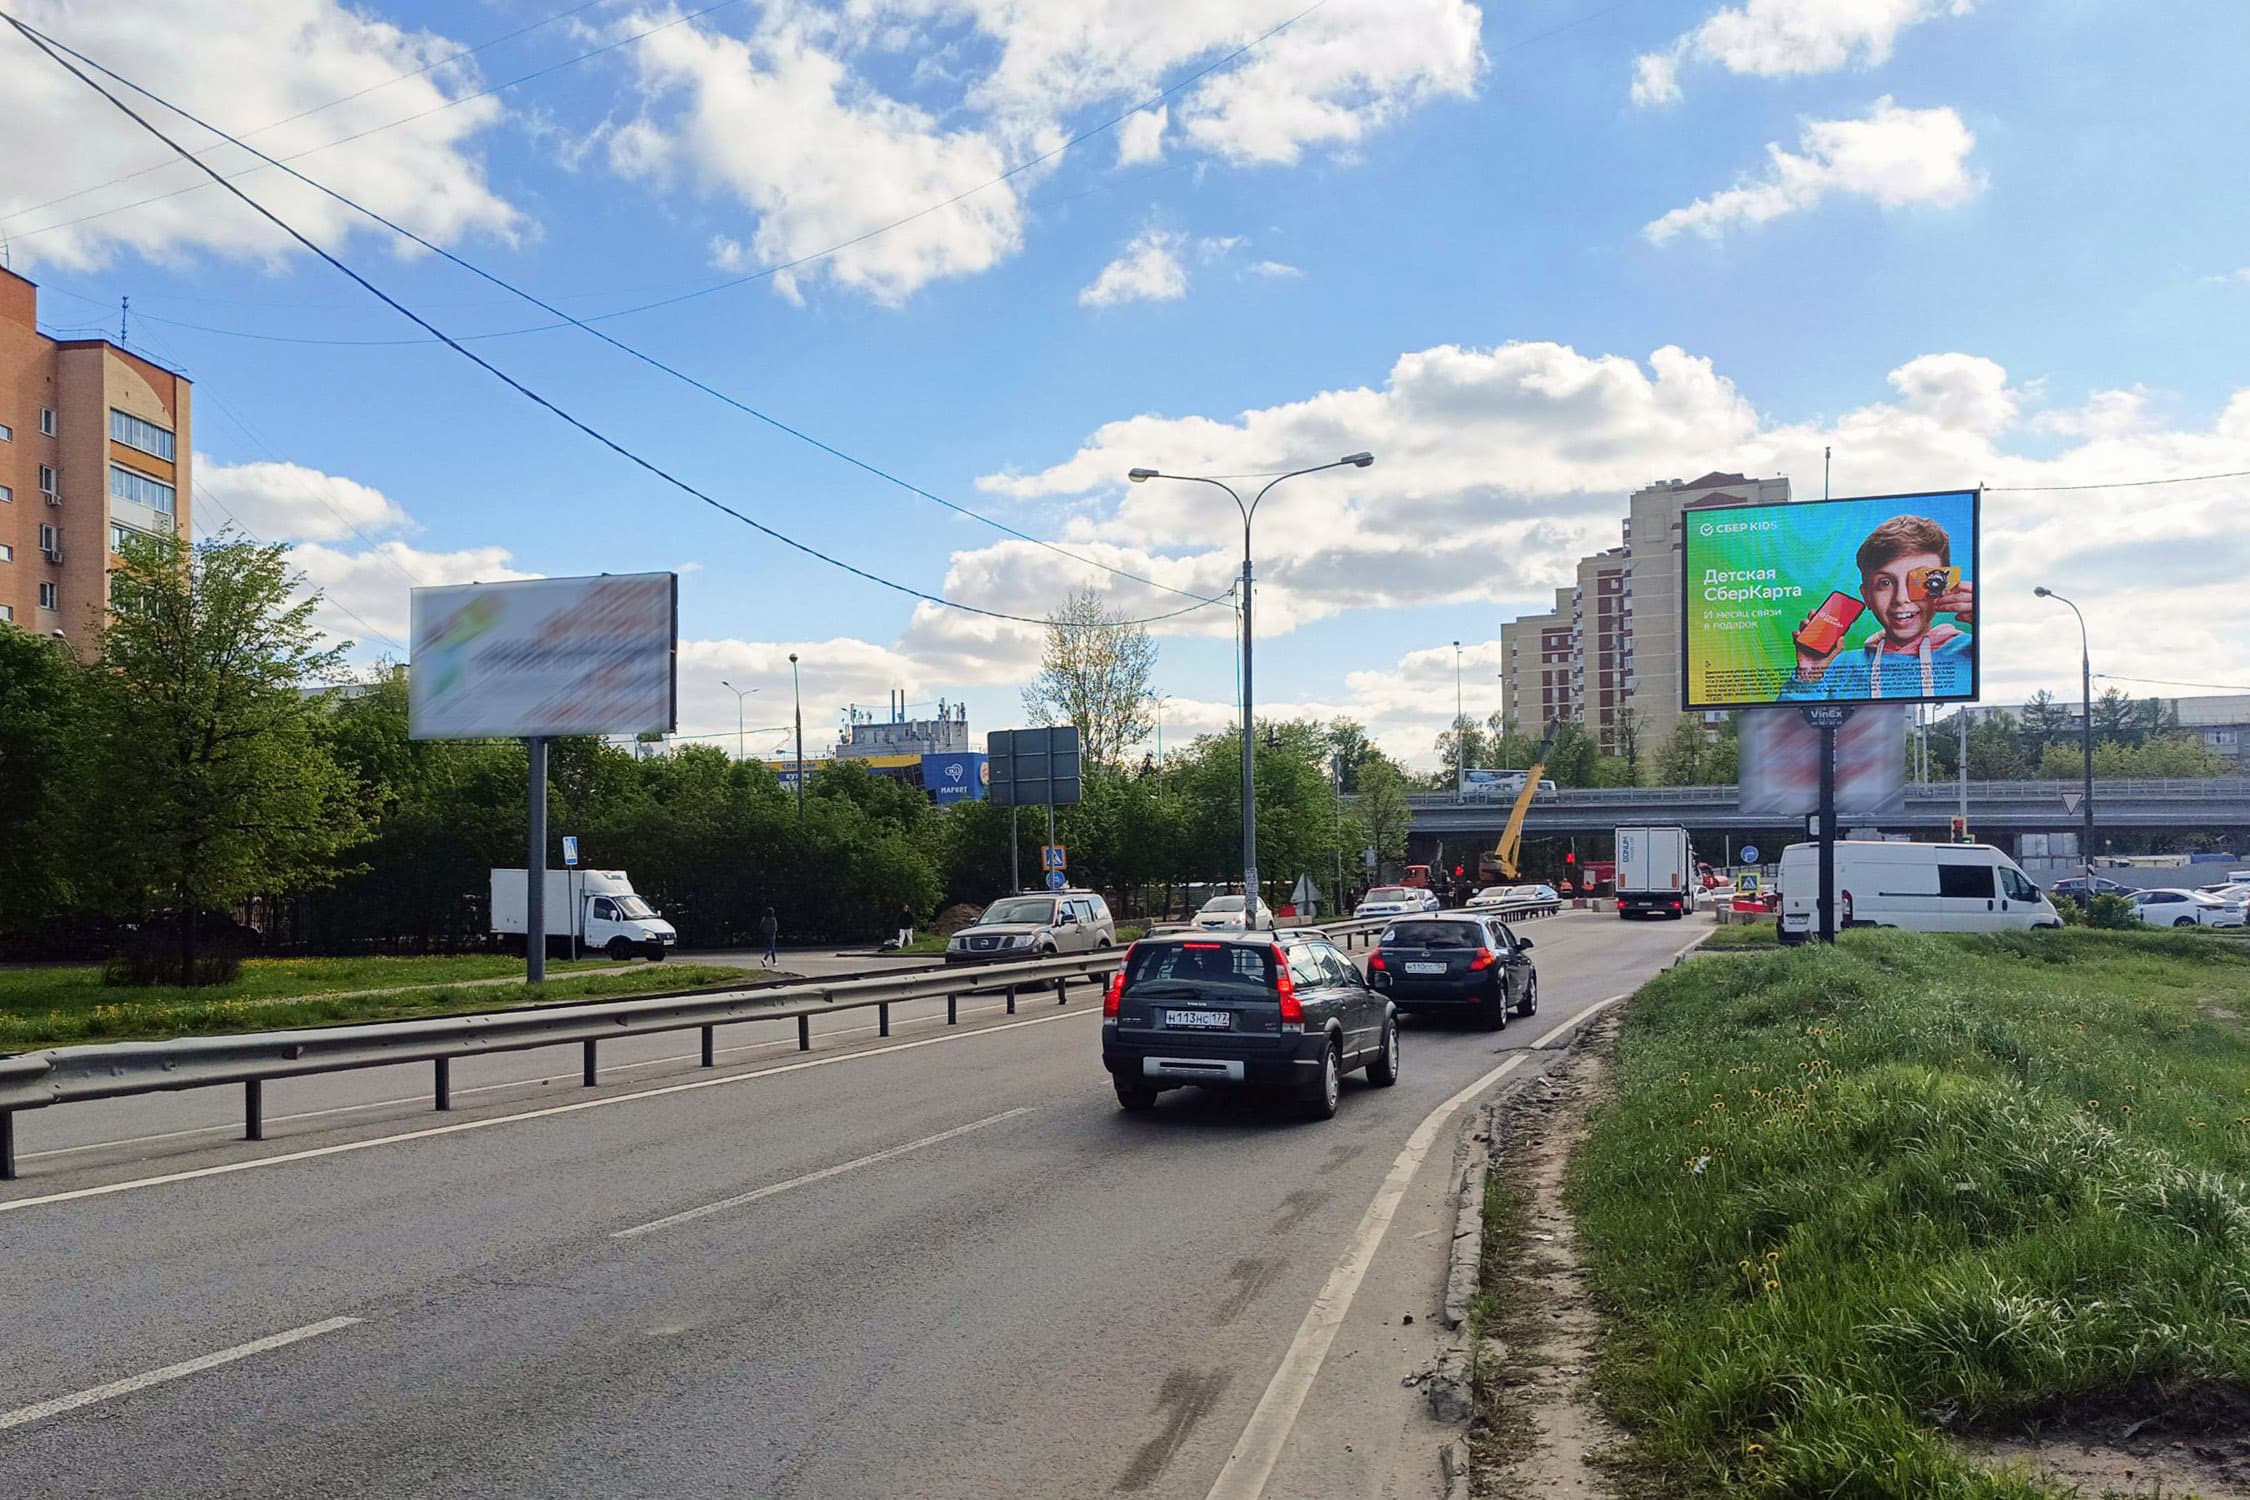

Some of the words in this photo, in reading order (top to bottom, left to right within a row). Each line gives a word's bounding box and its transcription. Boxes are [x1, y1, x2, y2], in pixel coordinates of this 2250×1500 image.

[1716, 523, 1748, 533] СБЕР
[1750, 521, 1778, 531] KIDS
[1703, 568, 1776, 585] Детская
[1704, 585, 1802, 603] СберКарта
[1751, 608, 1782, 618] связи
